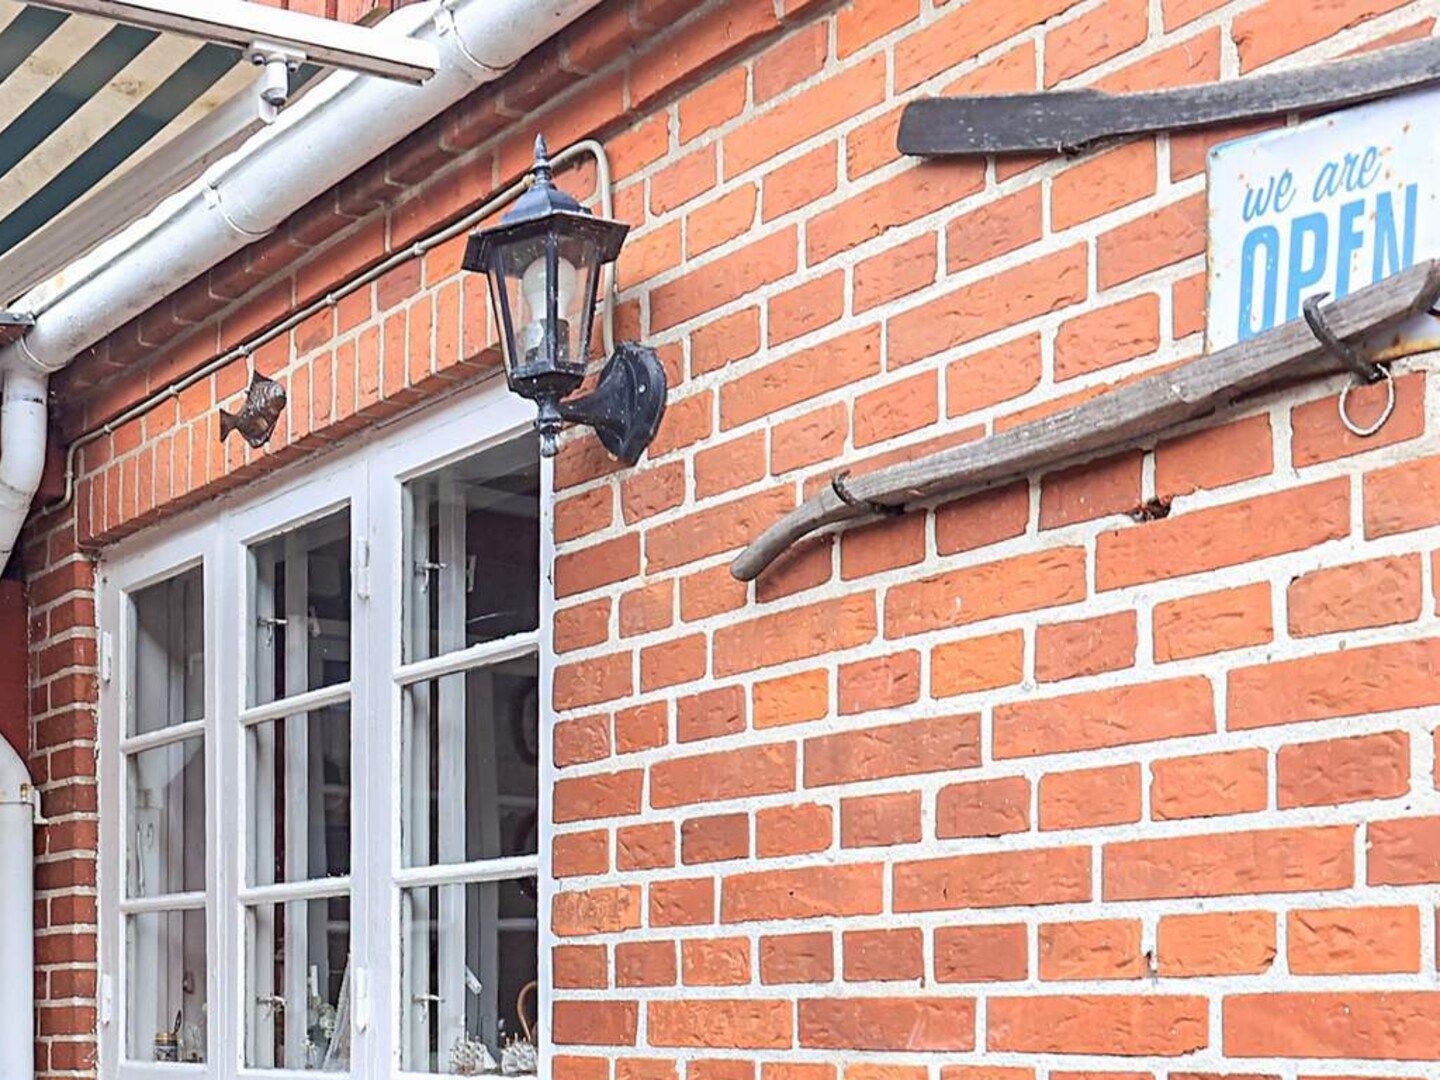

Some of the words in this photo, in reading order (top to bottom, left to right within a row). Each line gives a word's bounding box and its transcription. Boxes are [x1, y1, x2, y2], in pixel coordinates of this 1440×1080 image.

[1242, 168, 1298, 222] we
[1312, 146, 1382, 202] are
[1237, 183, 1418, 342] OPEN
